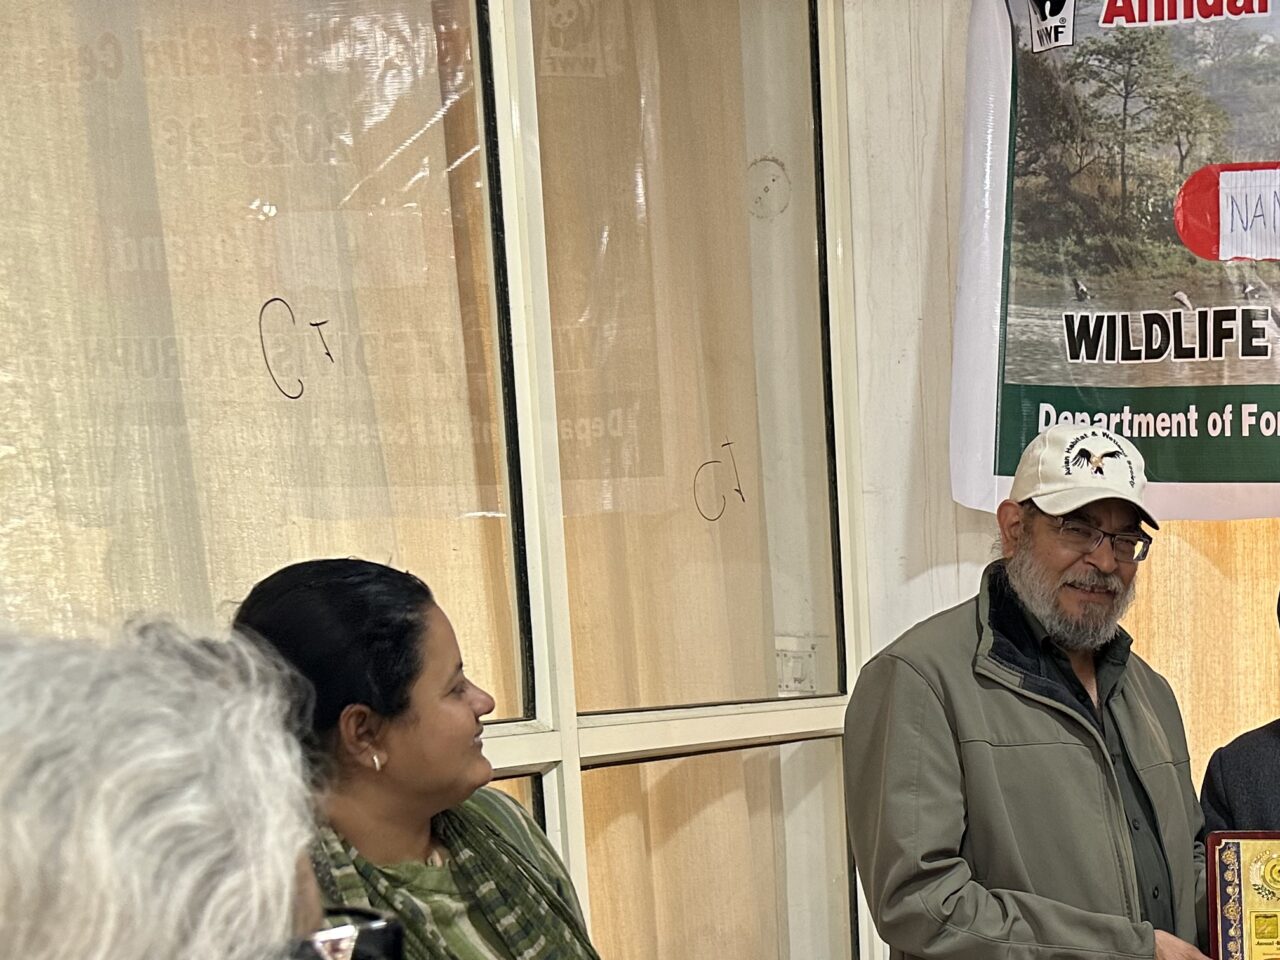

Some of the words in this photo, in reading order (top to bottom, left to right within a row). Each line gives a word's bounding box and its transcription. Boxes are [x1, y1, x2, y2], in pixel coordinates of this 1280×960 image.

[1063, 306, 1271, 363] WILDLIFE
[1207, 404, 1233, 437] of
[1065, 433, 1089, 454] Habitat
